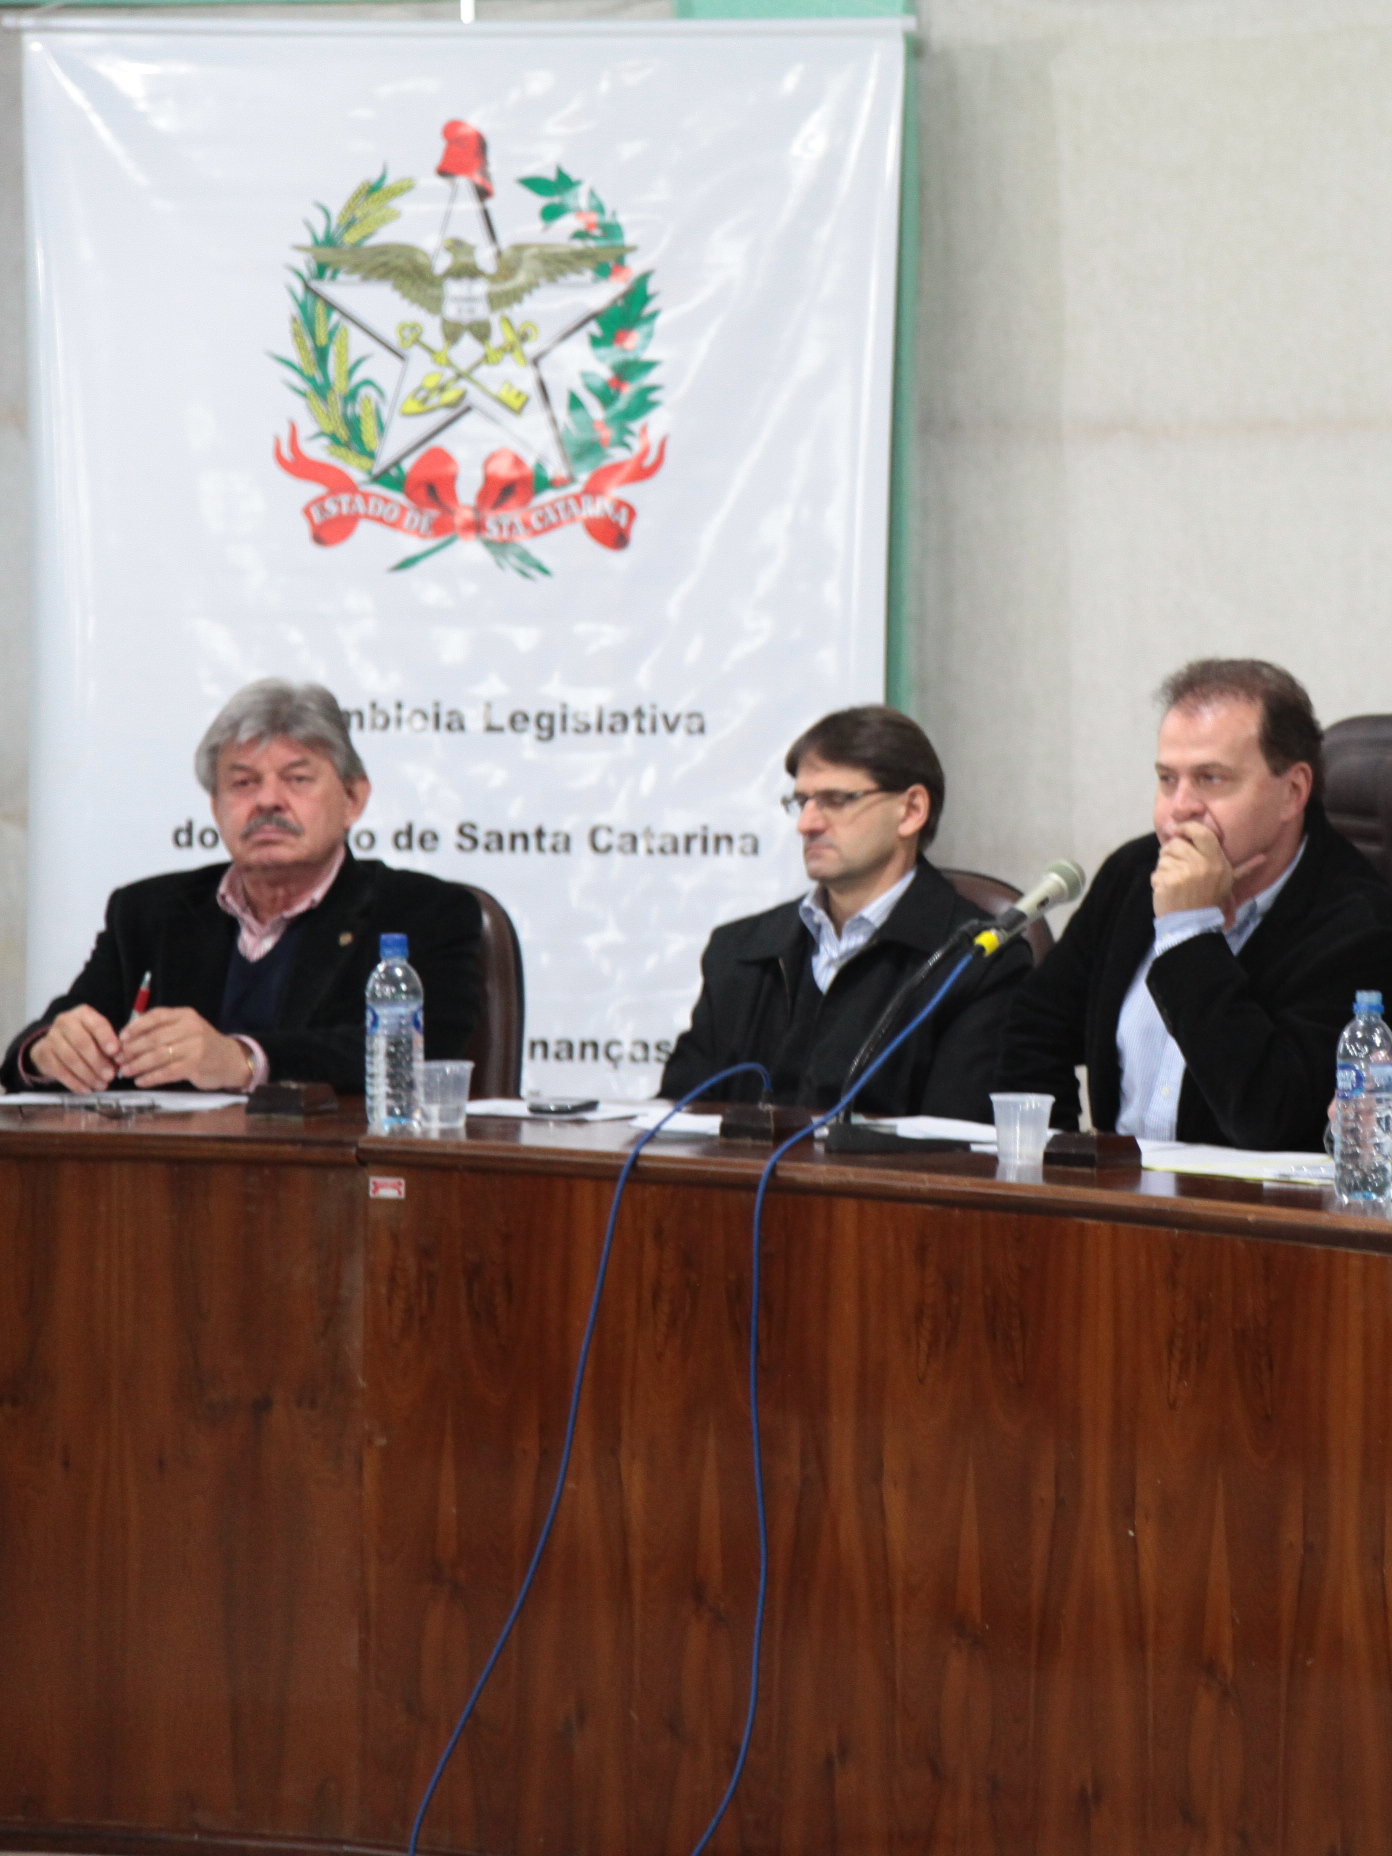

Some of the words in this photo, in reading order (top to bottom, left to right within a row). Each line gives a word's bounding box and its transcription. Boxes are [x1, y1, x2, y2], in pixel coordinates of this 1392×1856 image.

[310, 493, 400, 525] ESTADO
[403, 507, 440, 537] DE
[530, 494, 630, 531] CATARINA
[483, 701, 707, 742] Legislativa
[172, 818, 219, 849] do
[392, 821, 439, 852] de
[454, 820, 572, 854] Santa
[588, 823, 760, 856] Catarina
[528, 1035, 671, 1069] nanças
